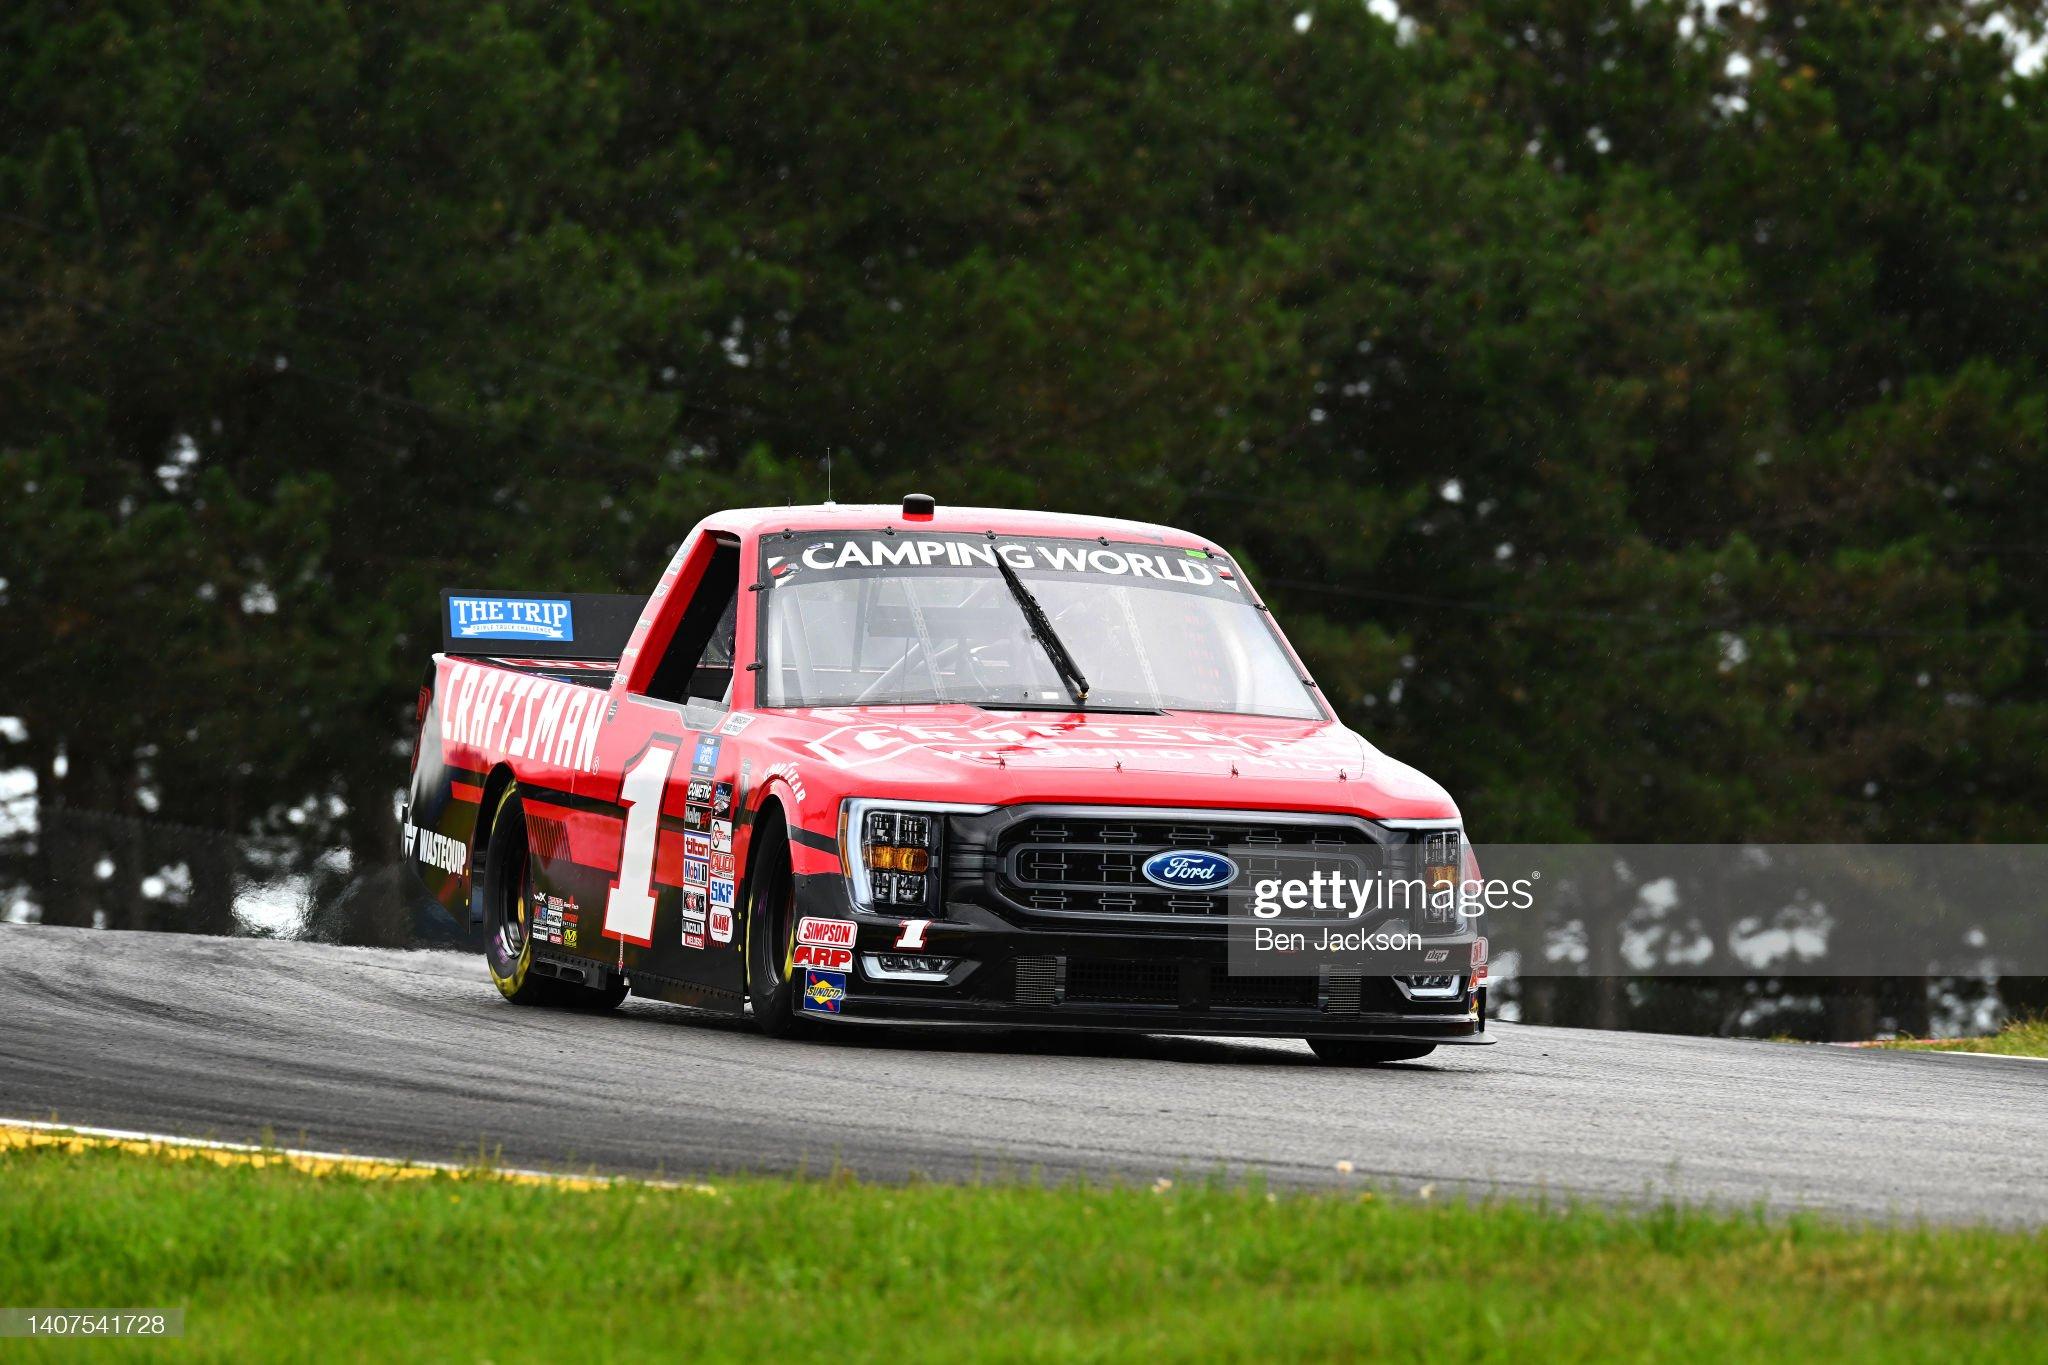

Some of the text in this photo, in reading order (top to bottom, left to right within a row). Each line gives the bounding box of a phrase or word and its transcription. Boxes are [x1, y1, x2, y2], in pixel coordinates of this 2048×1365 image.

[801, 540, 1214, 586] CAMPING WORLD
[453, 599, 568, 628] THE TRIP
[441, 662, 610, 773] CRAFTSMAN
[419, 827, 467, 876] WASTEQUIP
[605, 745, 676, 941] 1
[684, 860, 700, 881] Mobil
[702, 864, 707, 881] 1
[1163, 857, 1217, 880] Ford
[711, 880, 734, 904] SKF
[803, 921, 852, 944] SIMPSON
[896, 920, 929, 948] 1
[793, 946, 851, 968] ARP
[807, 985, 843, 999] SUNOCO
